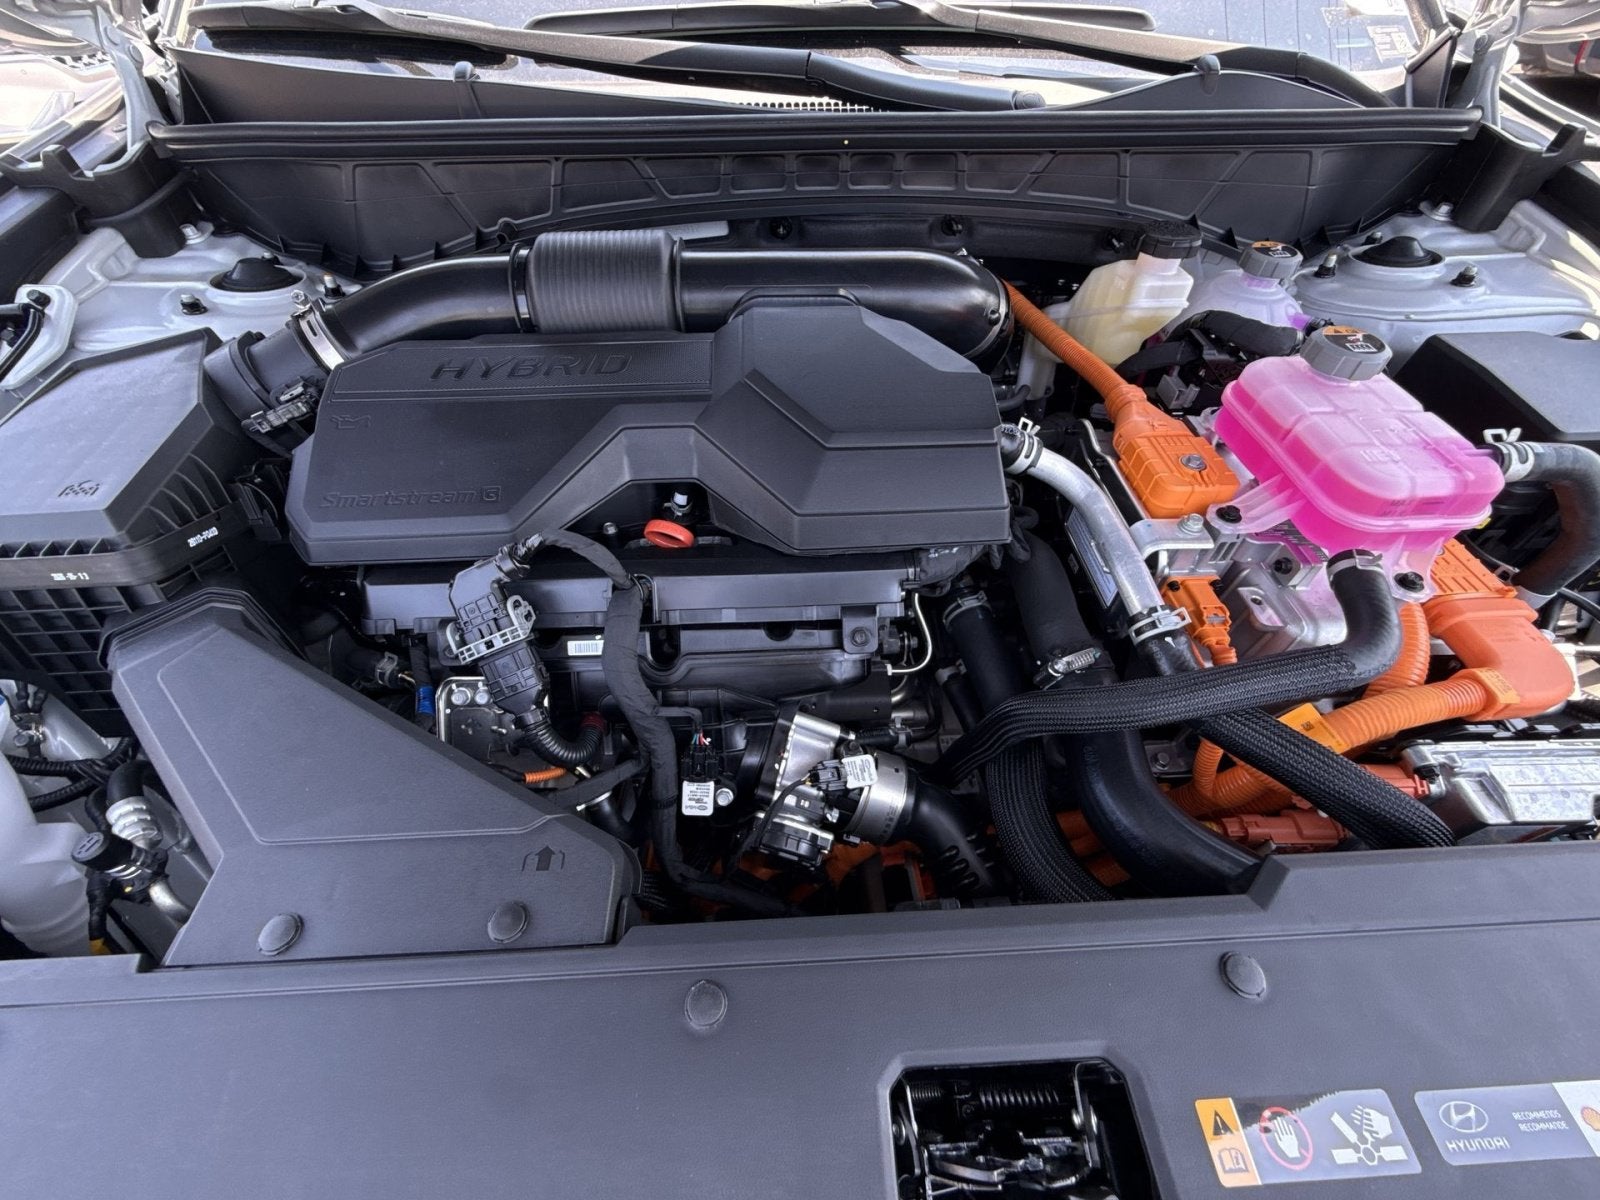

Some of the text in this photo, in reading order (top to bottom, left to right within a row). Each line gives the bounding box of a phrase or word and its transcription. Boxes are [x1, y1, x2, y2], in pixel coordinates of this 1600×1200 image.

[429, 353, 633, 380] HYBRID
[320, 490, 477, 509] Smartstream
[1512, 1109, 1562, 1121] RECOMMENDS
[1518, 1120, 1569, 1133] RECOMMANDE
[1446, 1136, 1511, 1153] HYUNDAI
